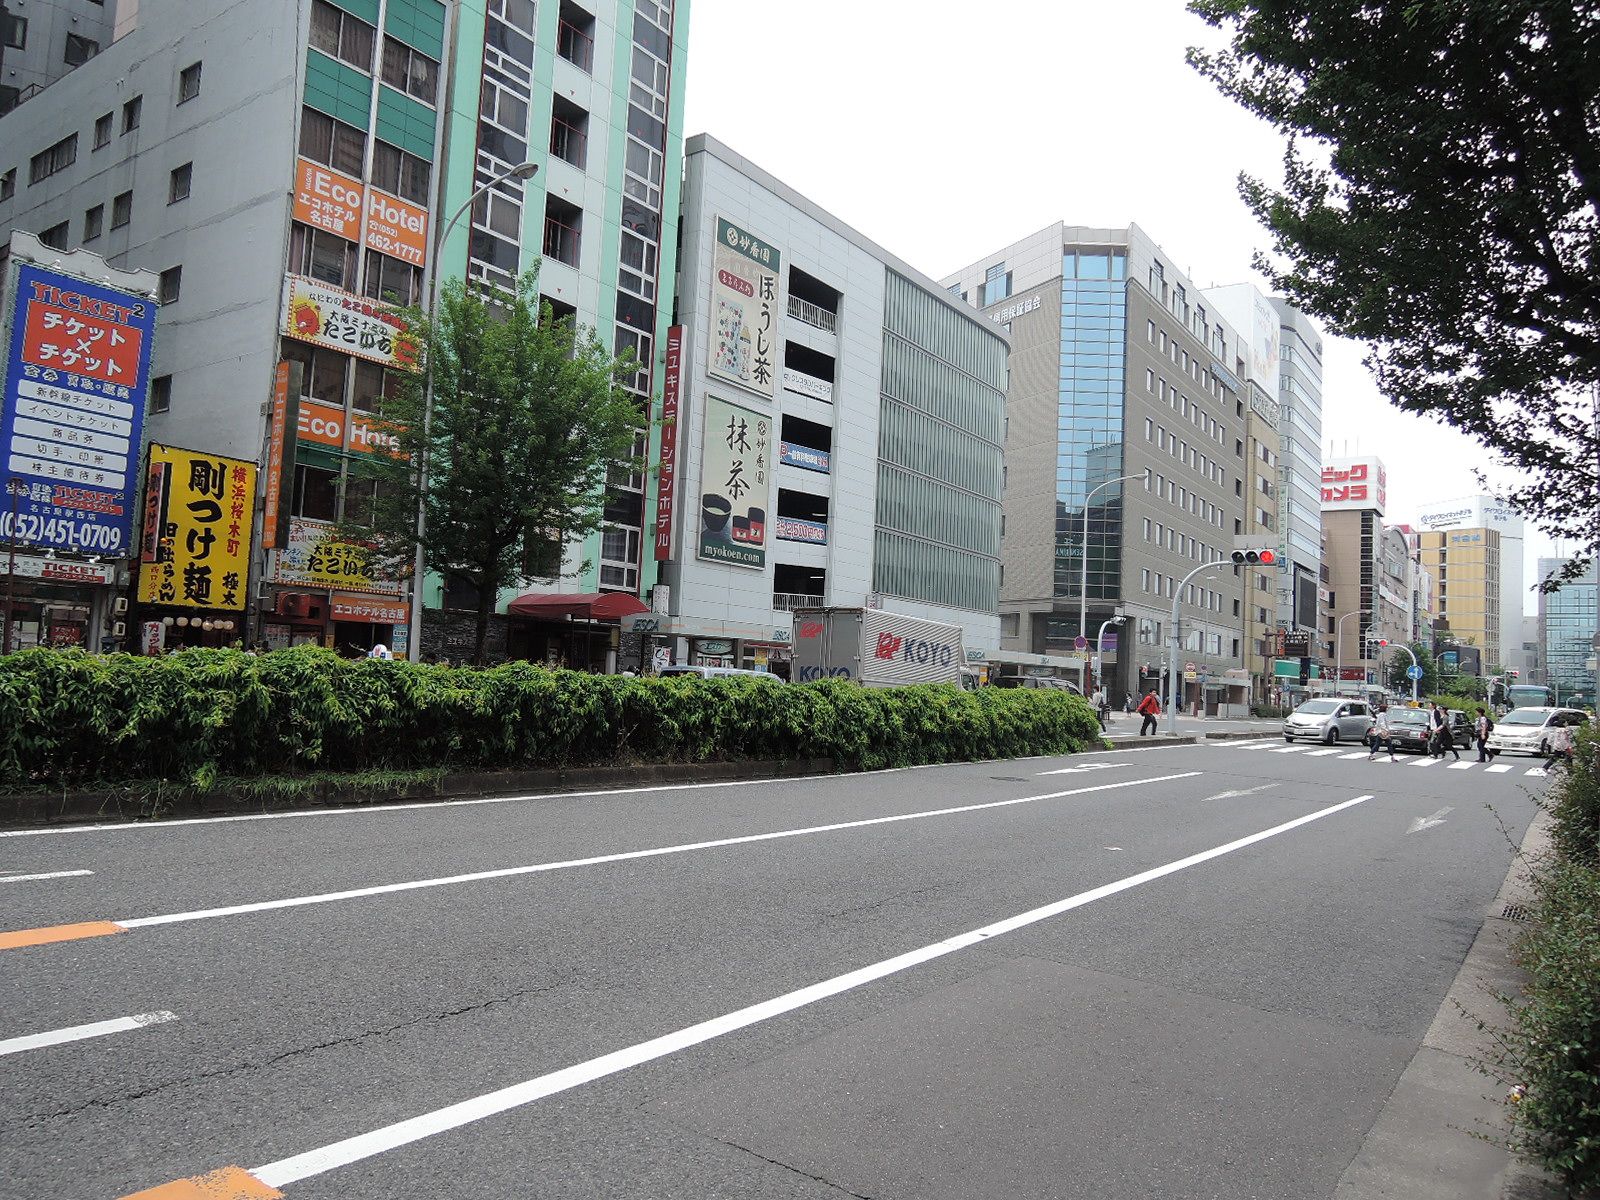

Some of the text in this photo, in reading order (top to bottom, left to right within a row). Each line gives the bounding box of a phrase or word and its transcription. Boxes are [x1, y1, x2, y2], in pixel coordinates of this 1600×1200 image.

[299, 192, 356, 223] エコホテル
[314, 170, 425, 235] Eco Hotel
[310, 208, 345, 233] 名古屋
[367, 231, 422, 262] 462-1777
[43, 311, 127, 348] チケット
[751, 272, 776, 386] ほうじ茶
[39, 342, 123, 377] チケット
[36, 386, 116, 412] 新幹線チケット
[29, 404, 119, 431] イベントチケット
[725, 414, 752, 501] 抹茶
[704, 545, 760, 563] myokoen.com
[334, 603, 406, 620] エコホテル名古屋
[904, 638, 951, 668] KOYO
